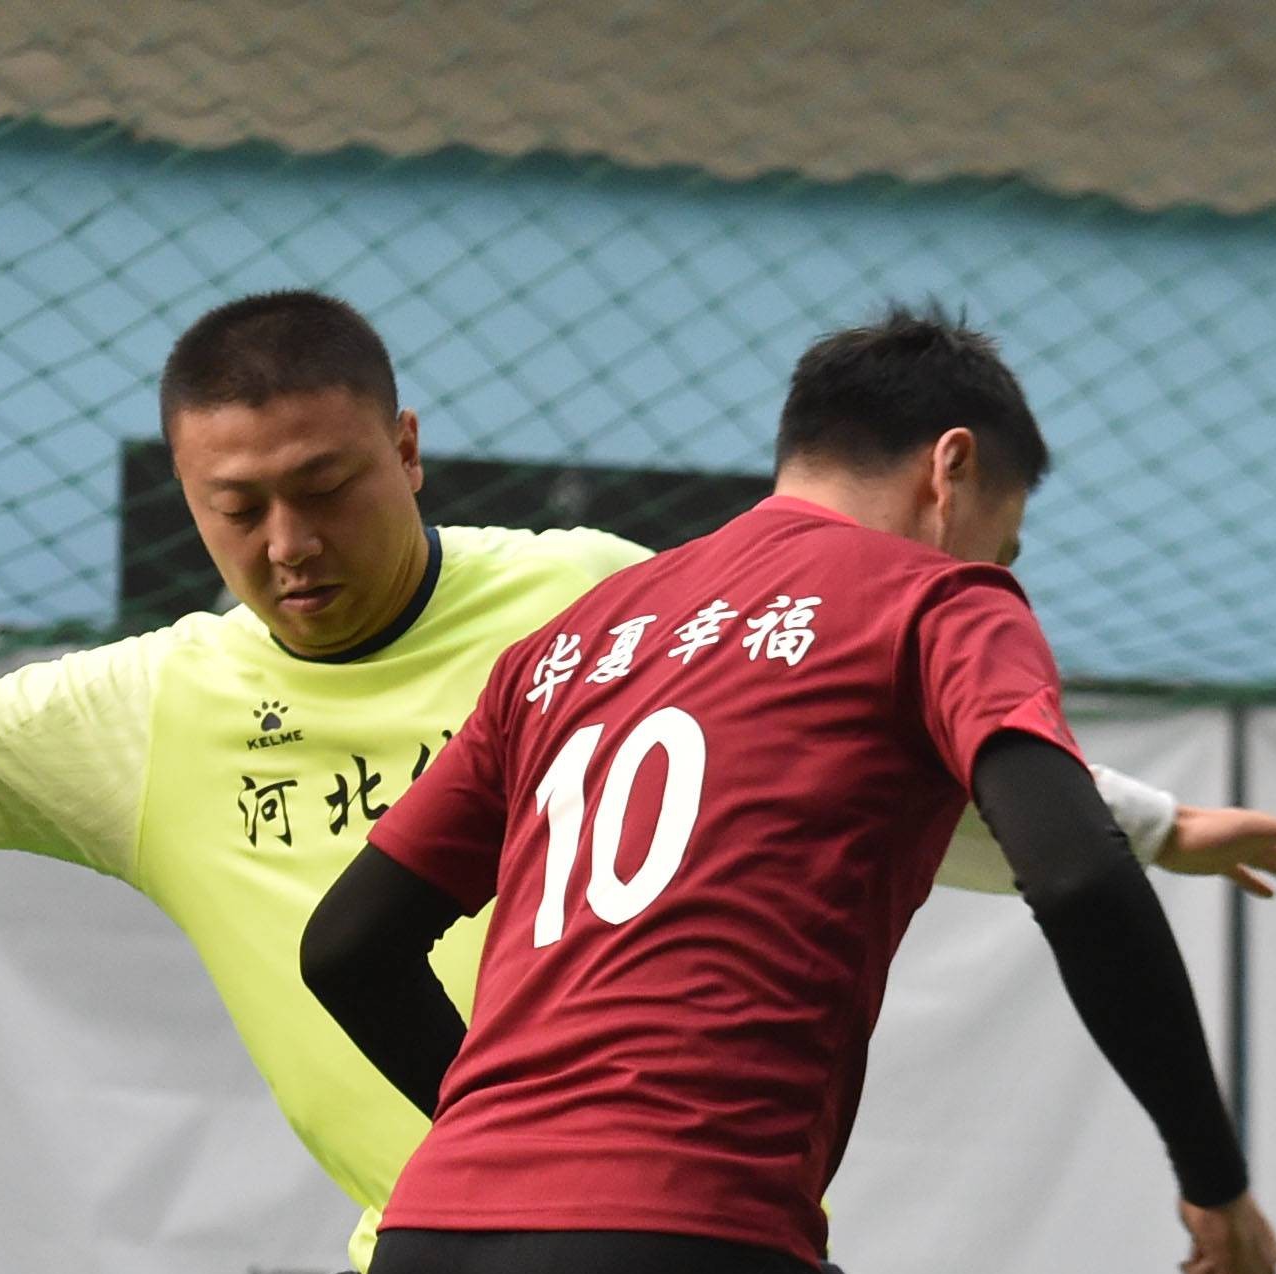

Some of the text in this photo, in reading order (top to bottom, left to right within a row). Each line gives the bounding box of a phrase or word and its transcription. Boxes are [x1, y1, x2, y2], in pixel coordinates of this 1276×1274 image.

[526, 595, 823, 714] 华夏幸福
[246, 729, 304, 750] KELME
[533, 706, 706, 949] 10
